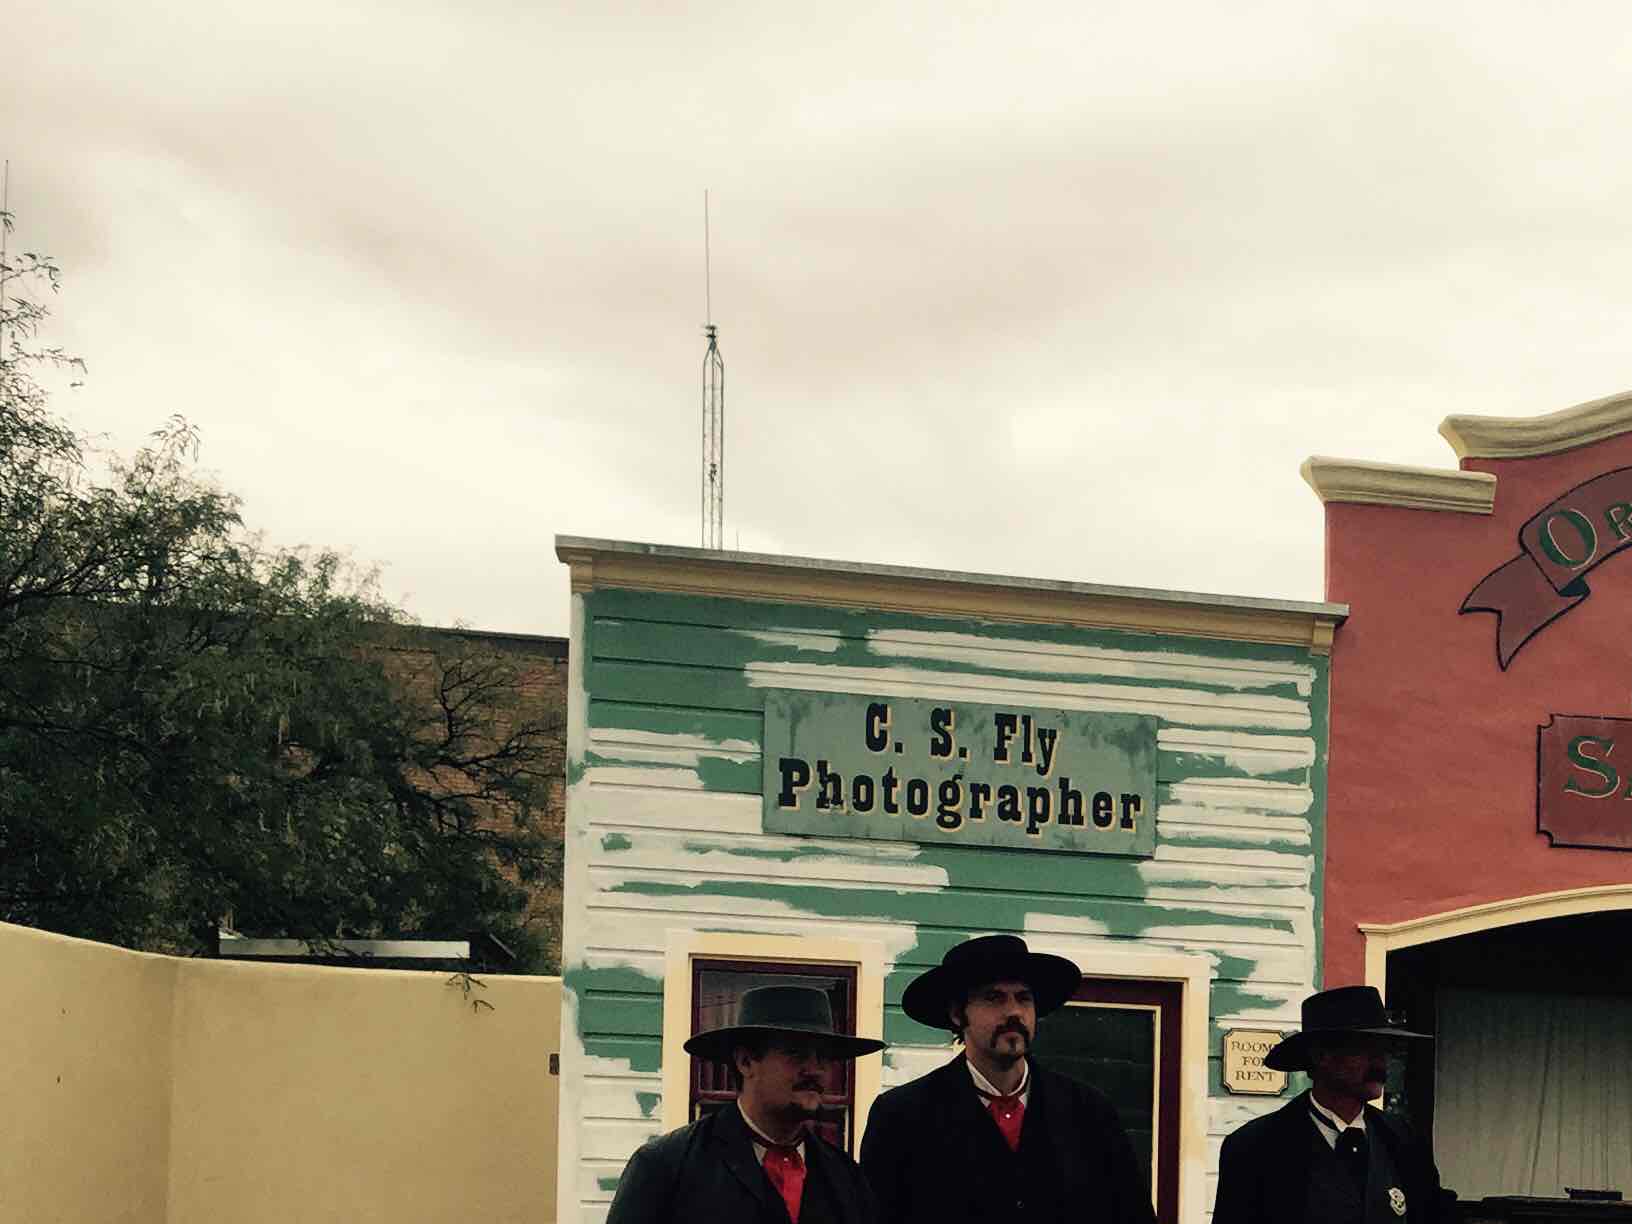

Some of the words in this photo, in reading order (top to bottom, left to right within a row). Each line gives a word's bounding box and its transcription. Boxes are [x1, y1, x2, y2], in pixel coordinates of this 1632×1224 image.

[865, 703, 904, 754] C.
[929, 707, 968, 760] S.
[993, 712, 1062, 778] Fly
[777, 757, 1143, 838] Photographer
[1231, 1041, 1271, 1052] ROOM
[1235, 1070, 1274, 1081] RENT
